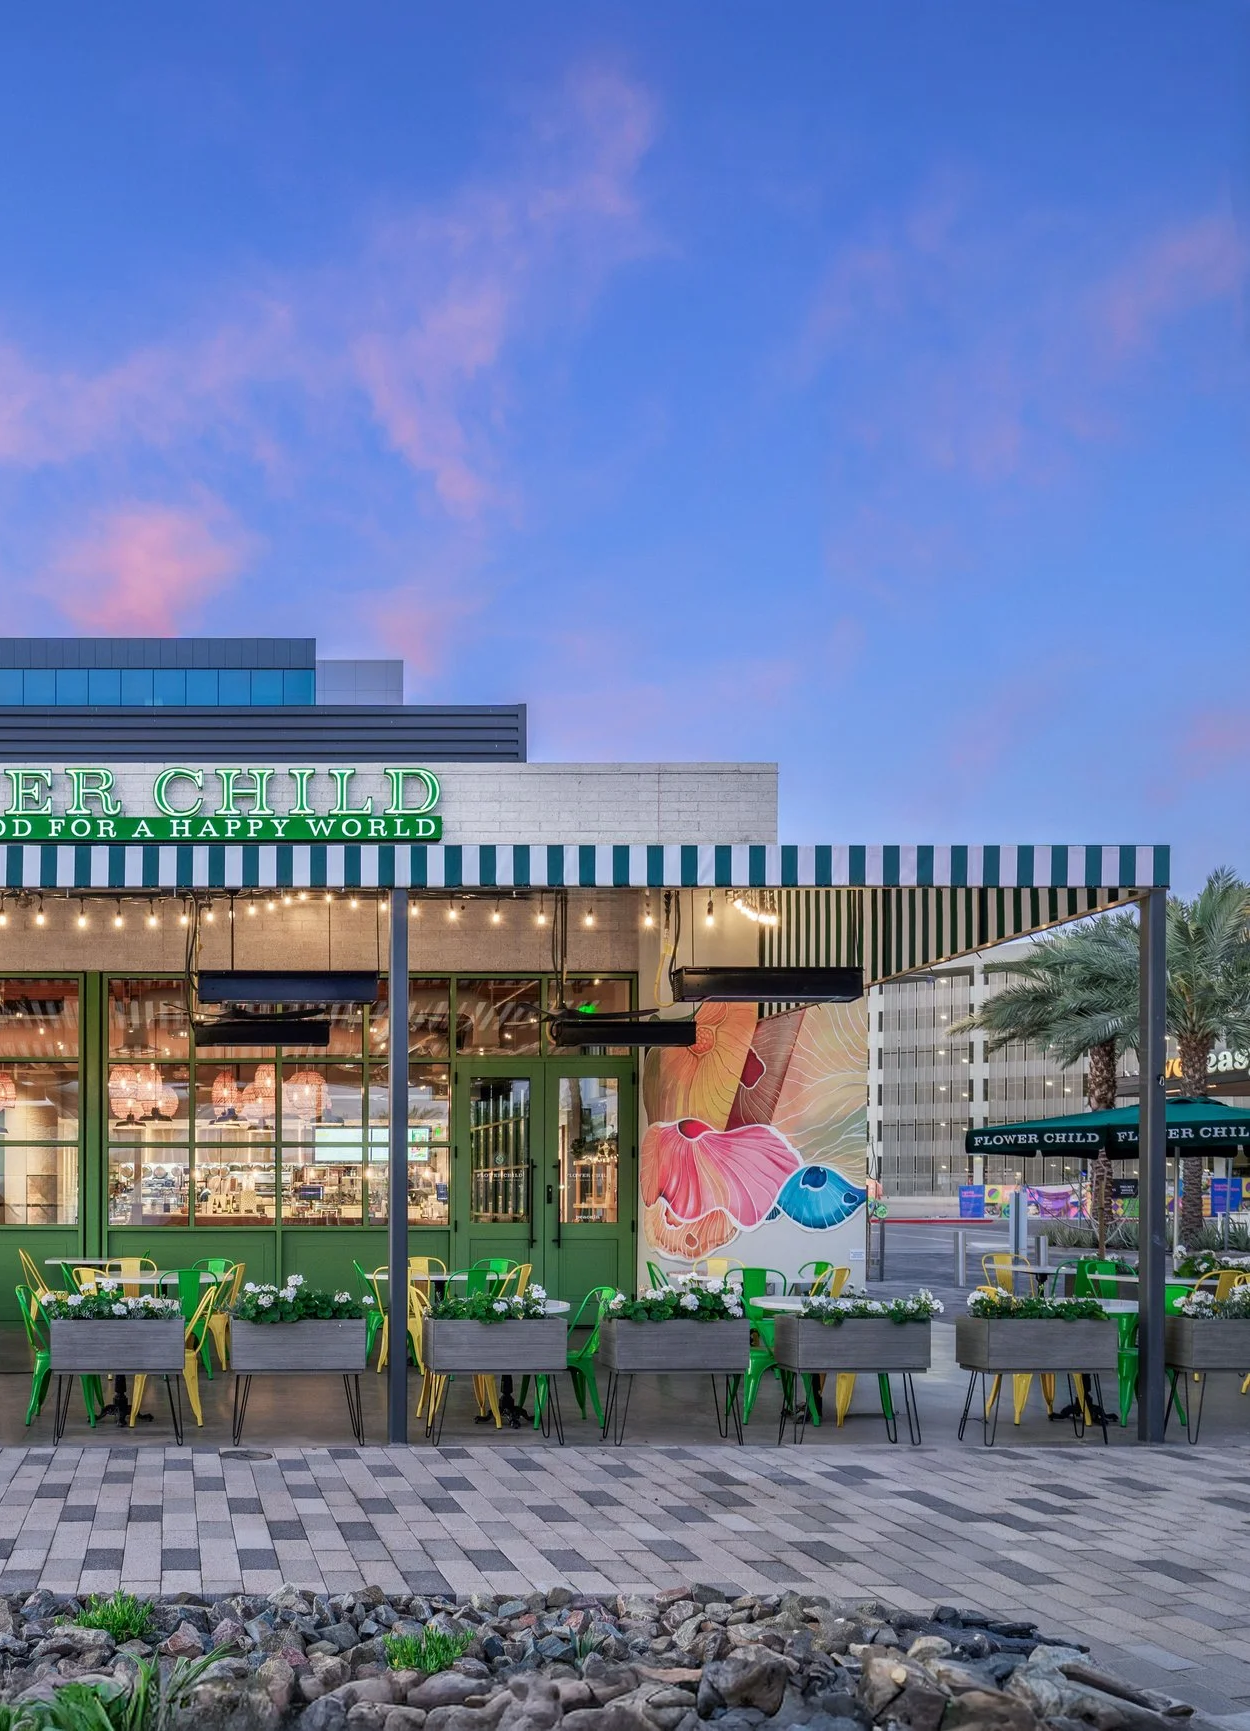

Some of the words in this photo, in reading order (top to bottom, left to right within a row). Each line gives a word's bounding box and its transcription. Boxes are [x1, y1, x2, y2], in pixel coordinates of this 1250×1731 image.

[153, 767, 442, 817] CHILD
[48, 818, 117, 838] FOR
[132, 818, 155, 838] A
[169, 818, 291, 838] HAPPY
[306, 818, 437, 838] WORLD
[1206, 1049, 1250, 1076] eas
[973, 1133, 1040, 1147] FLOWER
[1043, 1132, 1100, 1143] CHILD
[1116, 1127, 1195, 1142] FLER
[1199, 1126, 1250, 1138] CHIL
